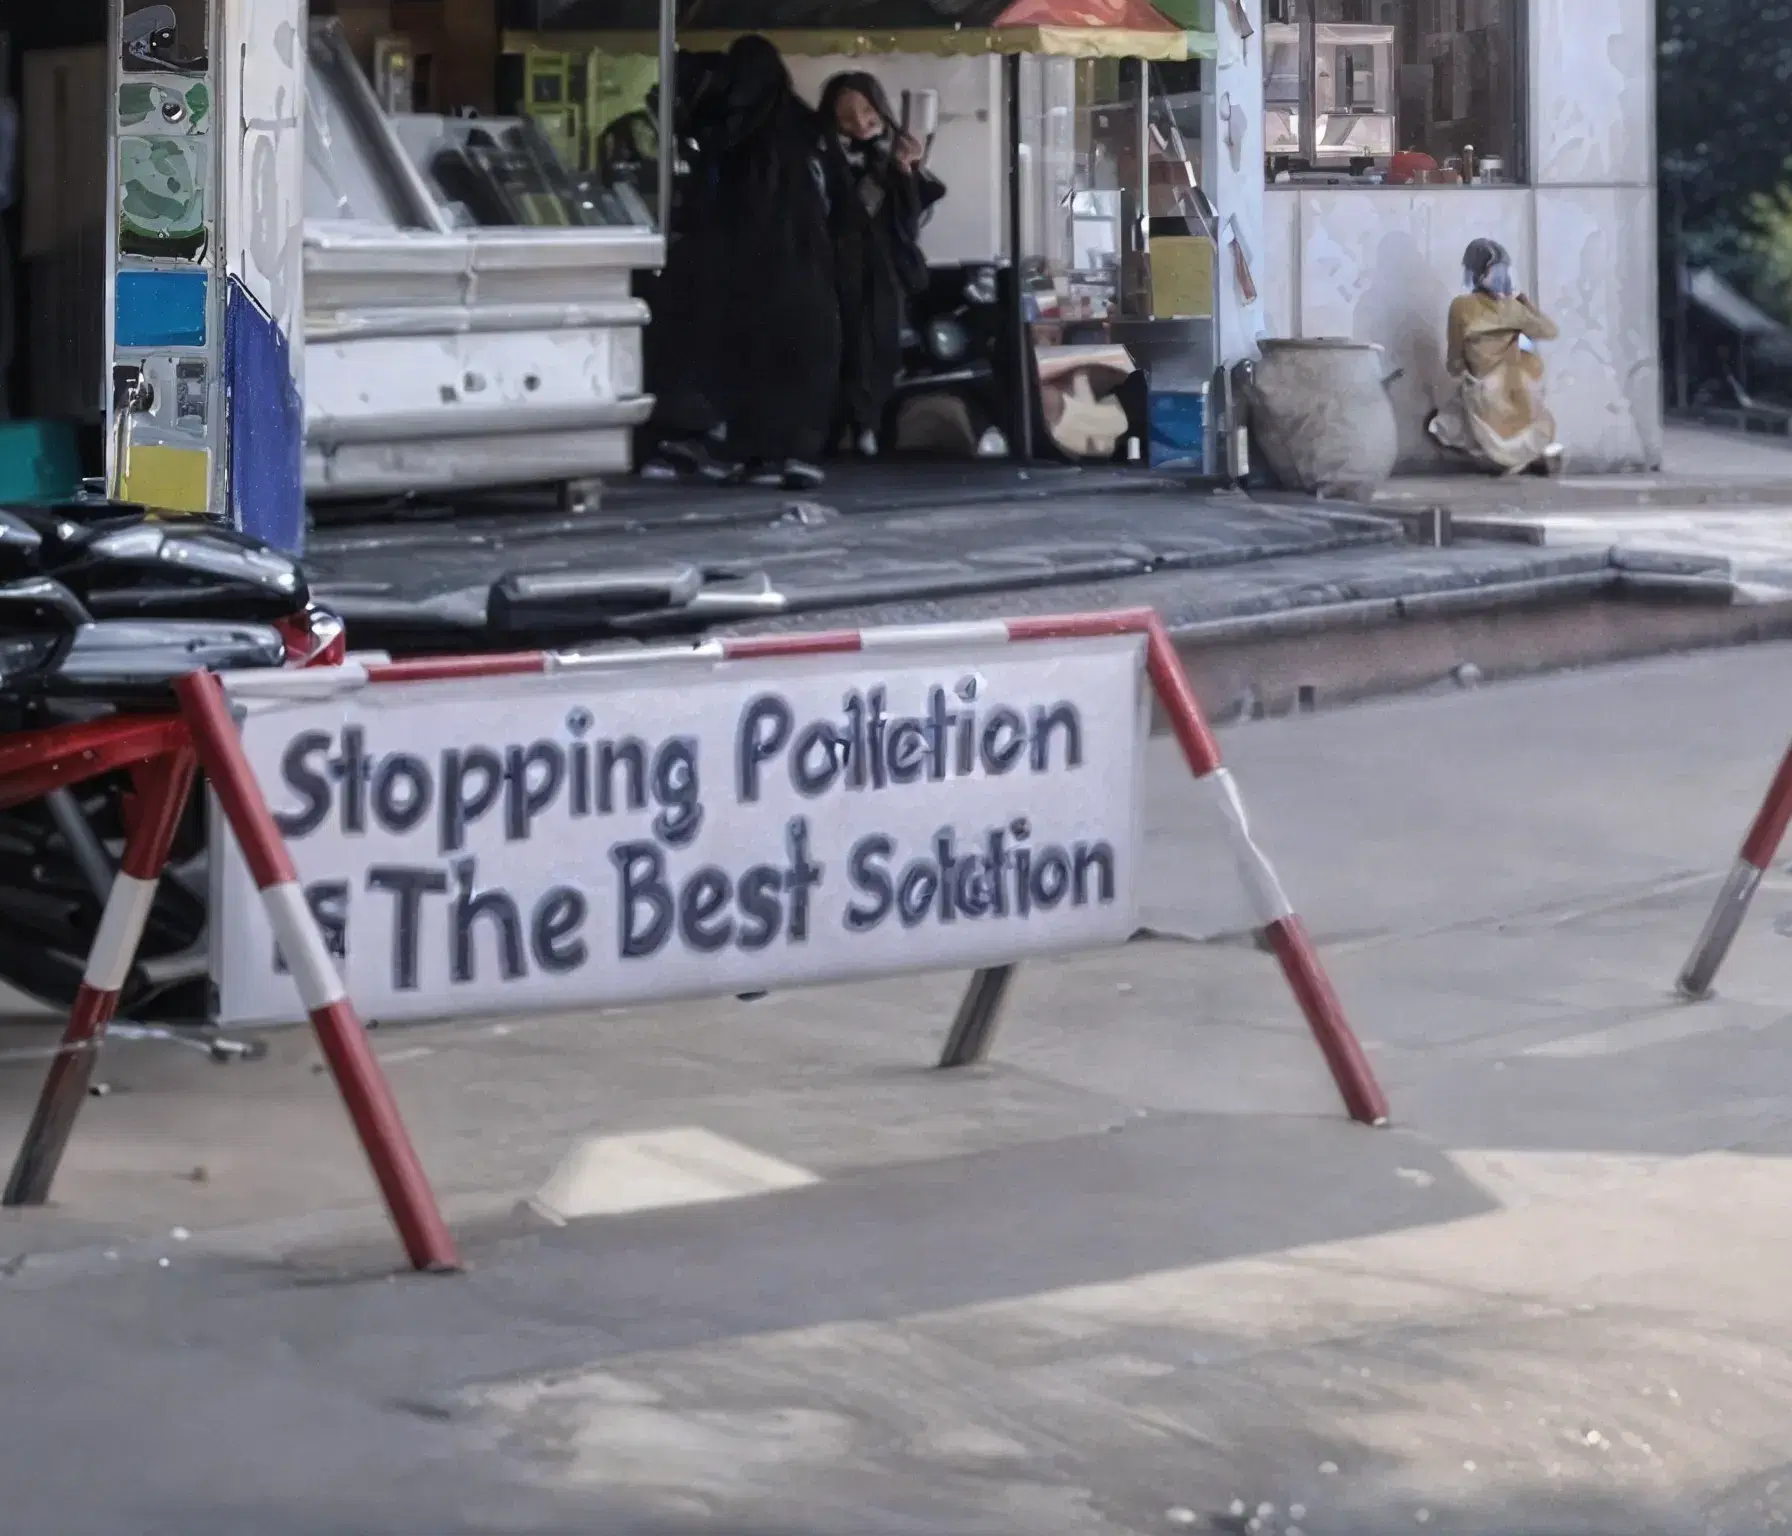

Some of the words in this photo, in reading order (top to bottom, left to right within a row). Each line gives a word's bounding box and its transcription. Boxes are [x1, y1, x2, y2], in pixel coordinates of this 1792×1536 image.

[274, 704, 700, 846] Stopping
[364, 854, 589, 992] The
[610, 814, 818, 960] Best
